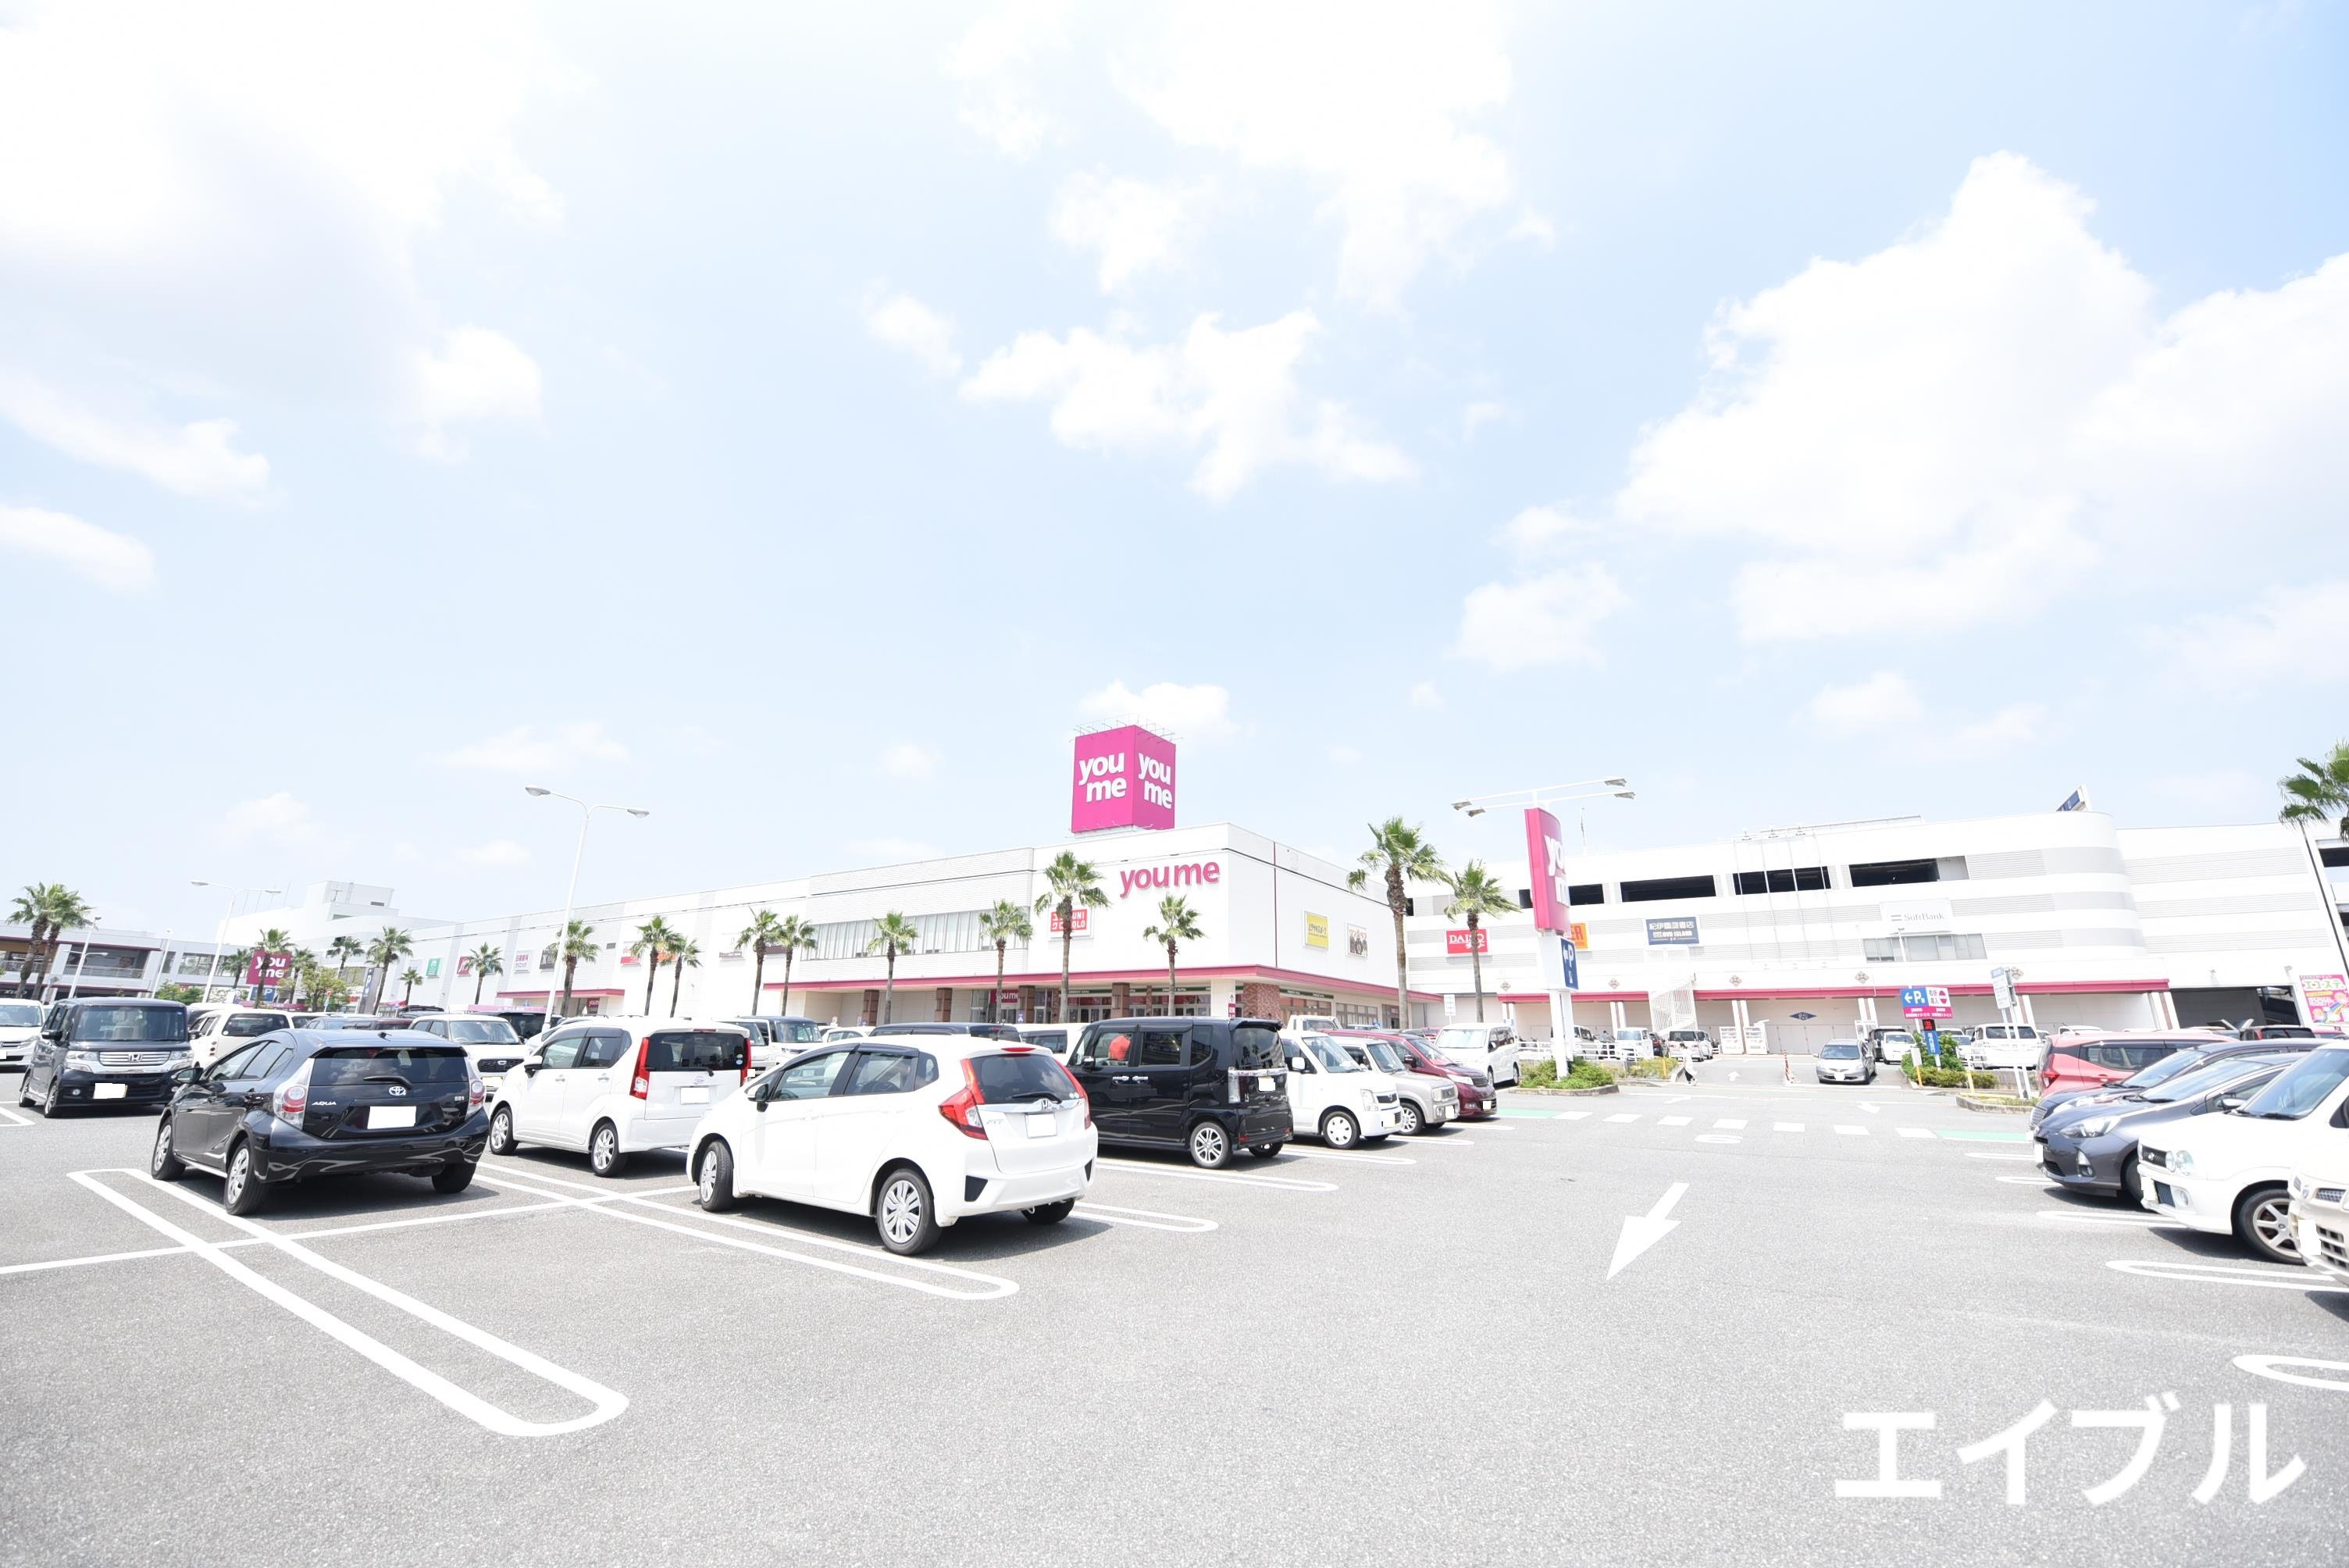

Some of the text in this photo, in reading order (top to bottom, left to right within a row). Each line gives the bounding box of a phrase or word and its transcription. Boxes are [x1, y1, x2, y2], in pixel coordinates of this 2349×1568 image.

[1078, 752, 1125, 786] you
[1138, 752, 1171, 786] you
[1086, 777, 1127, 804] me
[1144, 780, 1173, 809] me
[1903, 913, 1944, 921] SoftBank
[1567, 944, 1574, 968] P
